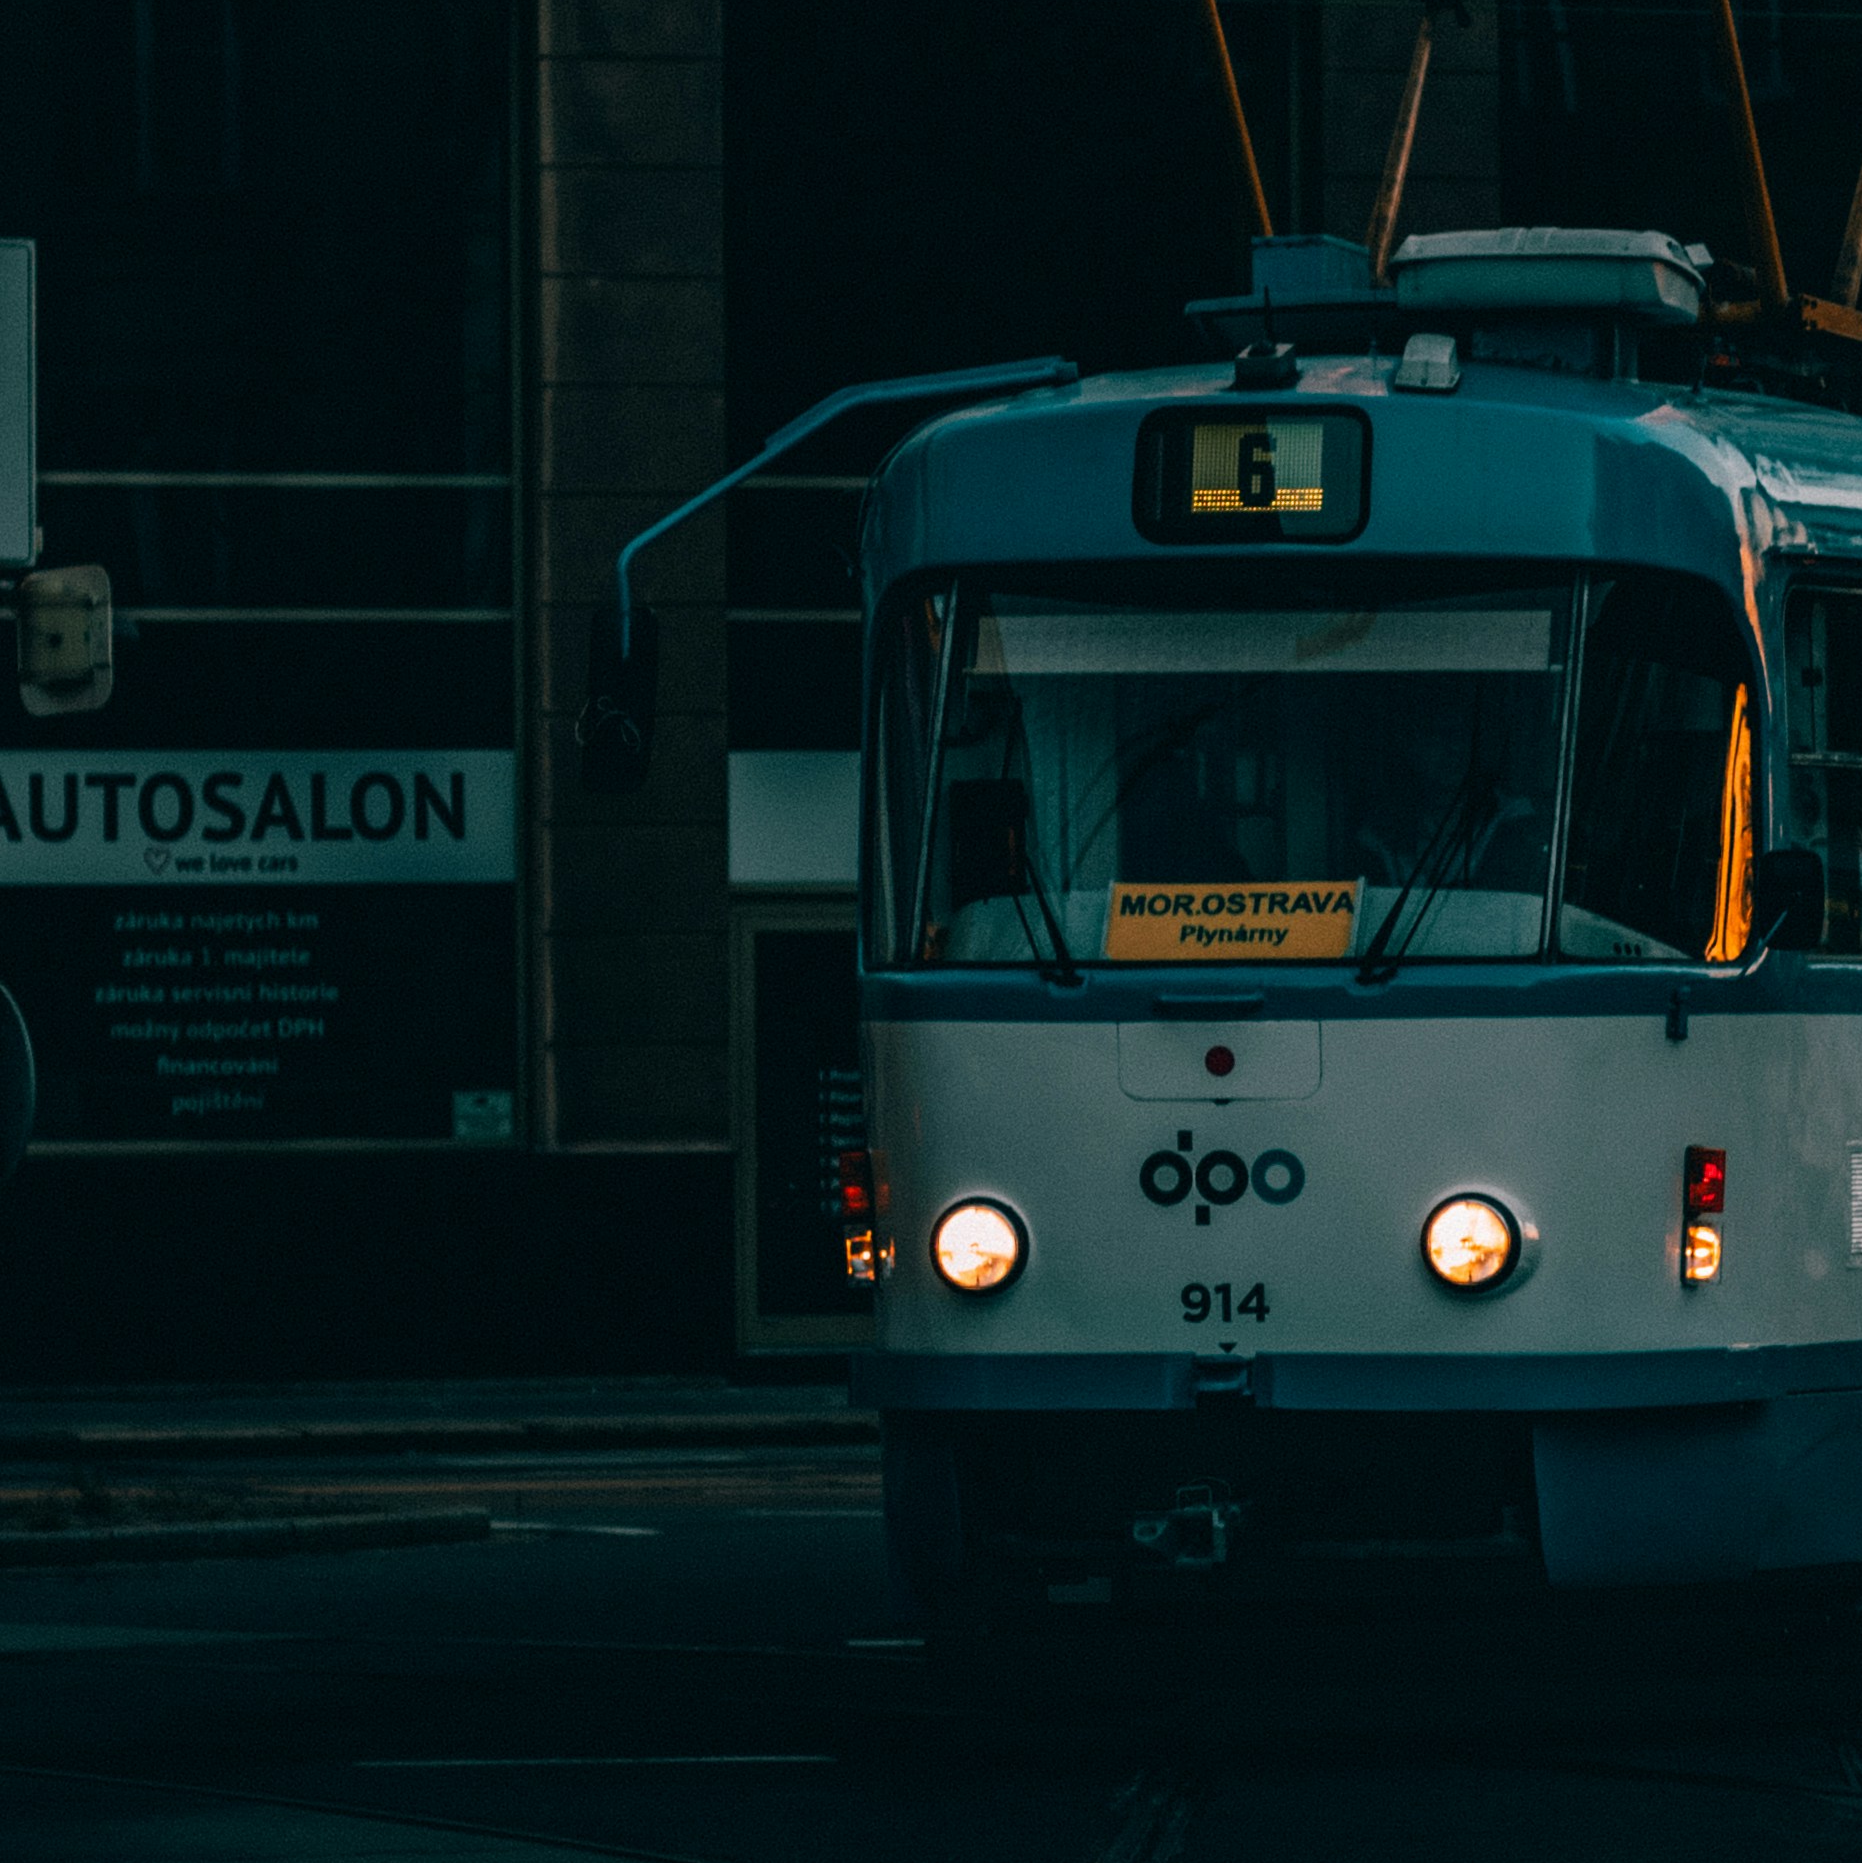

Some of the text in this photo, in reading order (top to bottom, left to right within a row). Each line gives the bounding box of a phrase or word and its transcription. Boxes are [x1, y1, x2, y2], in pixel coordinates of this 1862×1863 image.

[1237, 432, 1276, 508] 6
[176, 853, 299, 873] we love cars
[1119, 891, 1354, 917] MOR.OSTRAVA
[286, 911, 320, 931] km
[1179, 924, 1289, 946] Plynárny
[277, 1016, 325, 1039] DPH
[1181, 1281, 1270, 1324] 914
